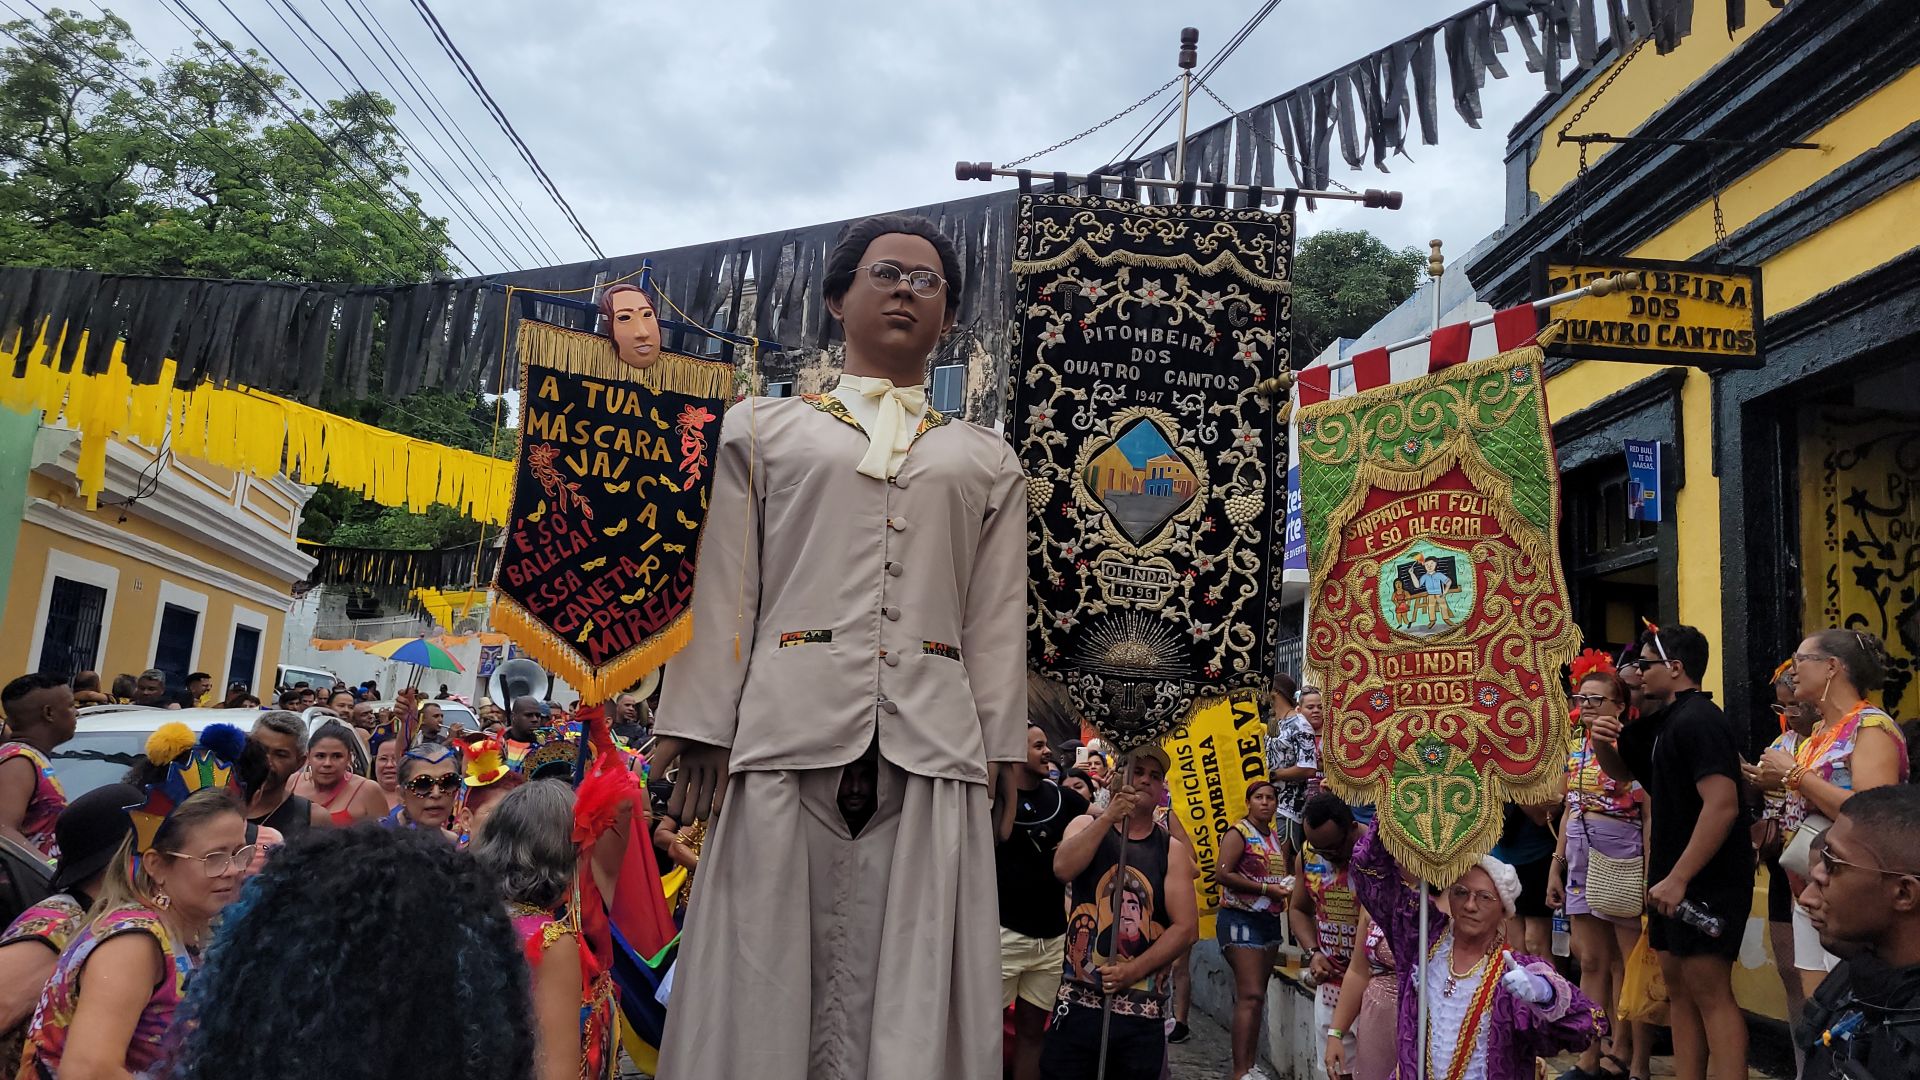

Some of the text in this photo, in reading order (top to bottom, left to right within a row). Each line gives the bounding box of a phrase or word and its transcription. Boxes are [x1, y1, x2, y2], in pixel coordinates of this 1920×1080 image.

[1629, 296, 1680, 319] DOS
[1083, 325, 1215, 356] PITOMBEIRA
[1657, 324, 1755, 352] CANTOS
[1131, 347, 1172, 364] DOS
[1064, 359, 1240, 391] QUATRO CANTOS
[538, 375, 643, 418] A TUA
[1135, 389, 1165, 404] 1947
[527, 402, 672, 463] MÁSCARA
[564, 448, 630, 480] VAI
[1629, 445, 1653, 455] RED BULL
[514, 501, 568, 553] É SÓ
[1347, 502, 1413, 541] SINPMOL
[1418, 494, 1440, 513] NA
[1408, 516, 1481, 537] ALEGRIA
[506, 519, 598, 587] BALELA!
[1105, 565, 1168, 584] OLINDA
[526, 569, 583, 614] ESSA
[554, 556, 640, 633] CANETA
[1119, 586, 1153, 599] 1996
[592, 601, 625, 629] DE
[1386, 651, 1473, 678] OLINDA
[1400, 681, 1466, 705] 2006
[1236, 735, 1264, 781] DE
[1178, 744, 1207, 820] OFICIAIS
[1193, 824, 1220, 908] CAMISAS
